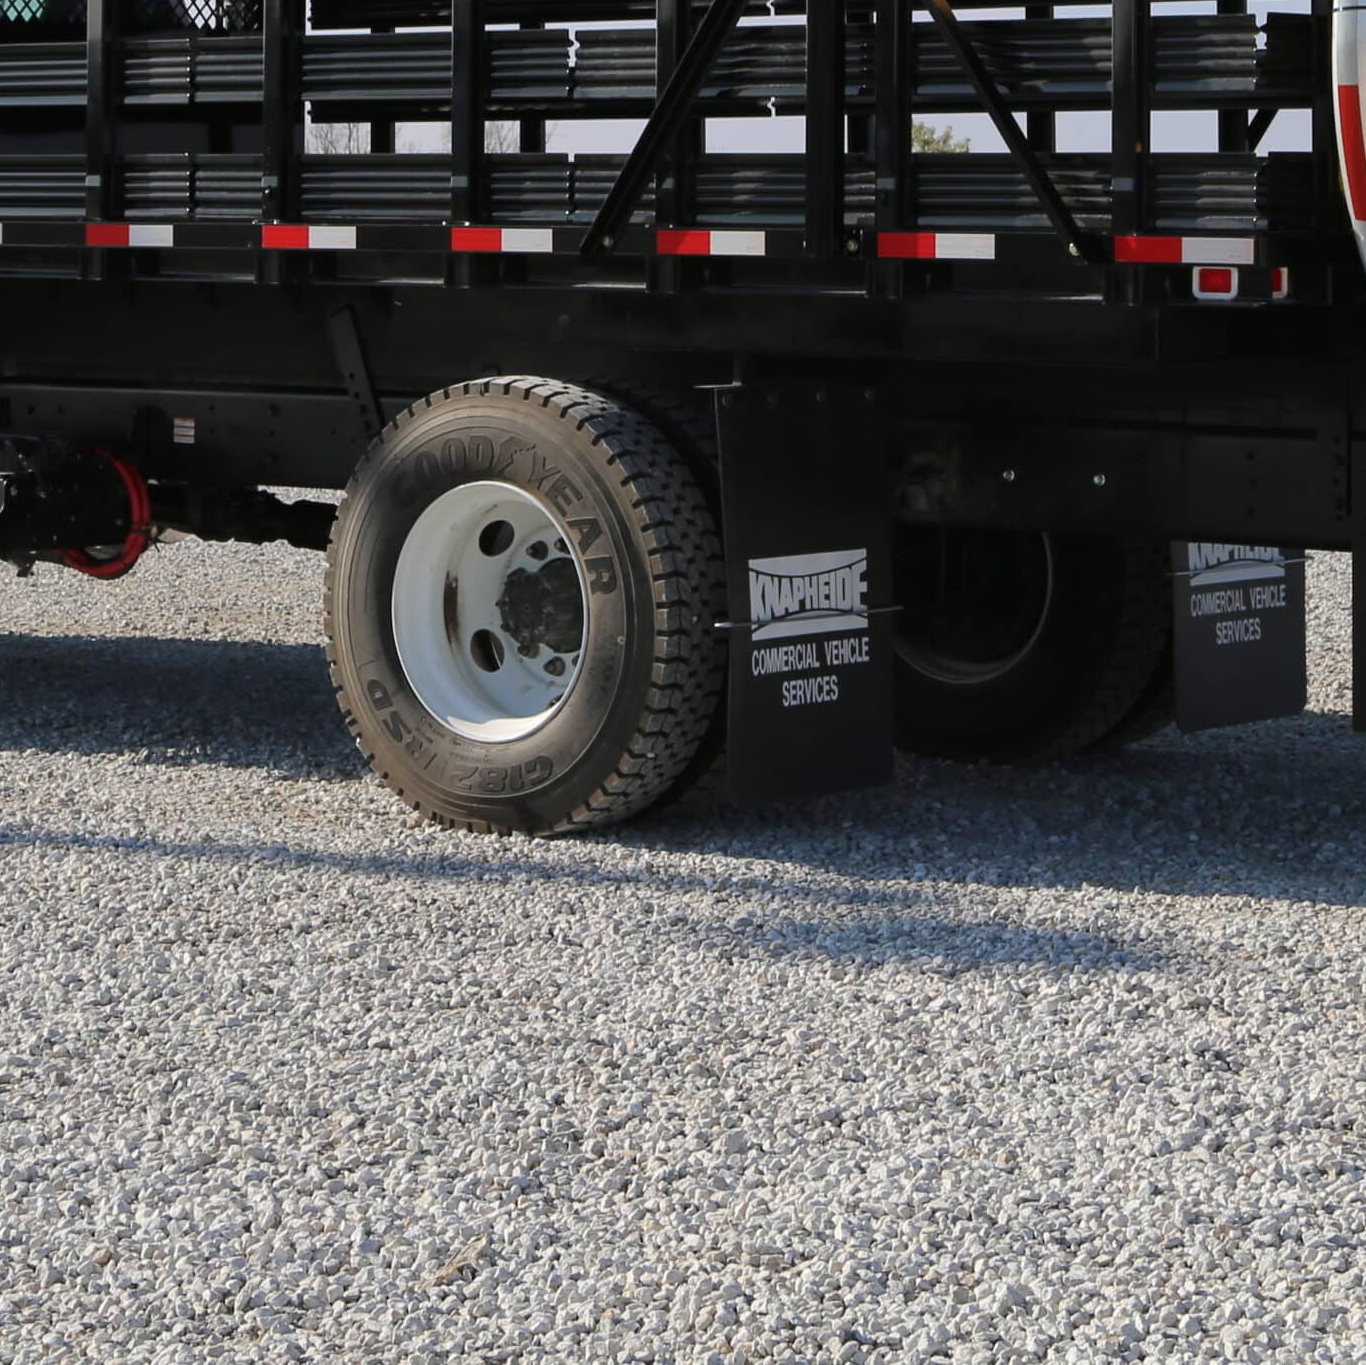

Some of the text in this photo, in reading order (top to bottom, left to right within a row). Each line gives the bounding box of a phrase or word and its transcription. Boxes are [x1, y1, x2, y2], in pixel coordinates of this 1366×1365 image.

[749, 560, 868, 630] KNAPHEIDE
[1191, 585, 1286, 617] COMMERCIAL VEHICLE
[1216, 618, 1261, 645] SERVICES
[752, 637, 870, 676] COMMERCIAL VEHICLE
[782, 675, 839, 707] SERVICES
